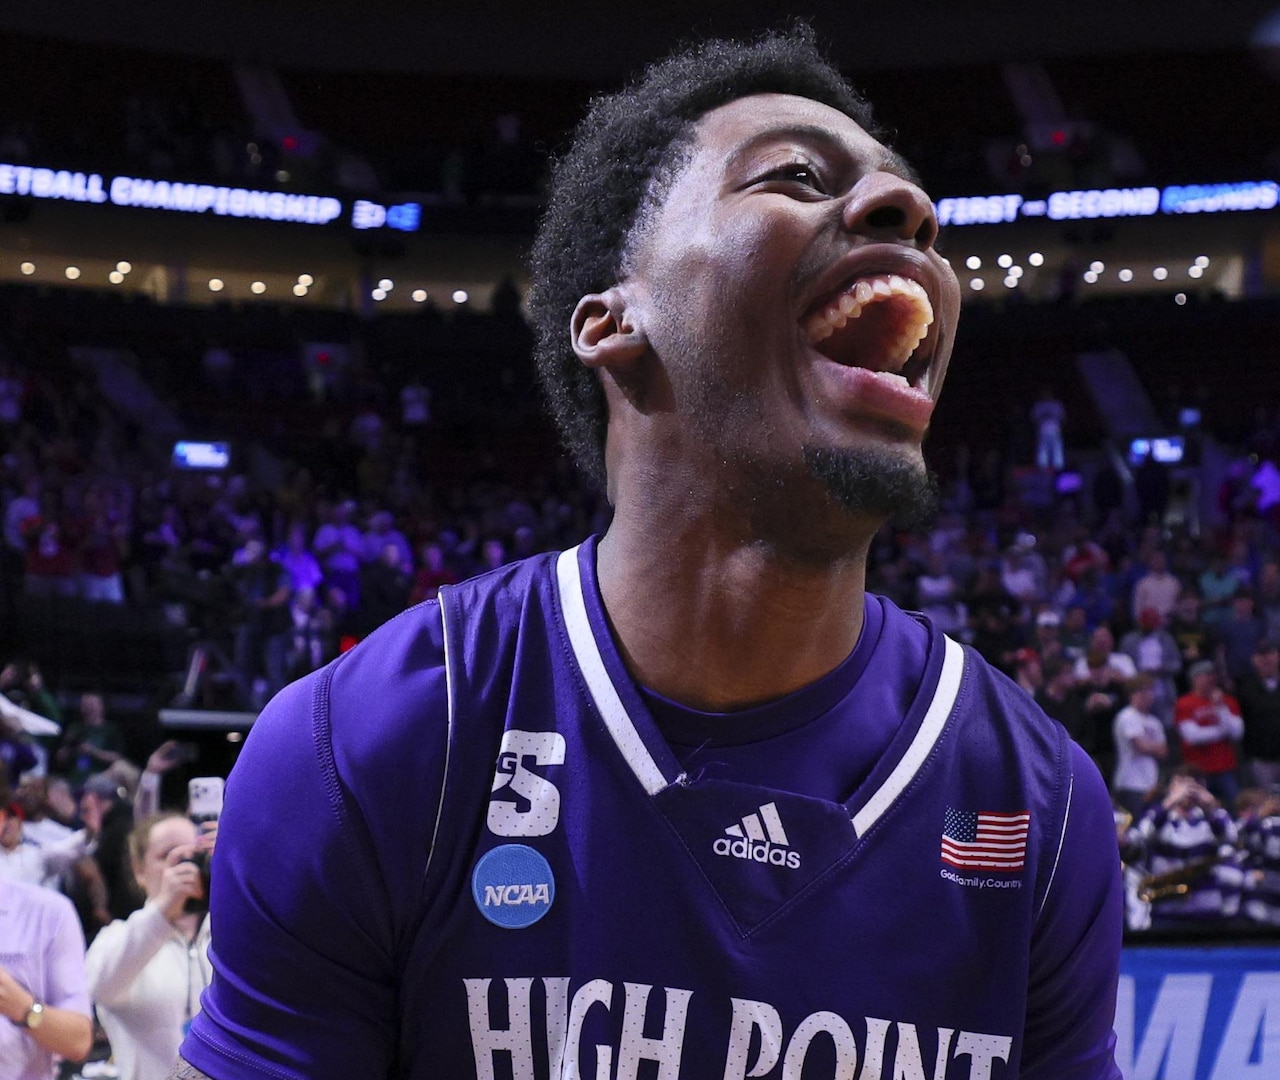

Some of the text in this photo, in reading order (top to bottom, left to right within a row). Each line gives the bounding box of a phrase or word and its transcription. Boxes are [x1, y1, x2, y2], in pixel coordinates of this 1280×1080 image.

[110, 175, 342, 225] CHAMPIONSHIP
[712, 837, 801, 869] adidas
[483, 883, 550, 907] NCAA
